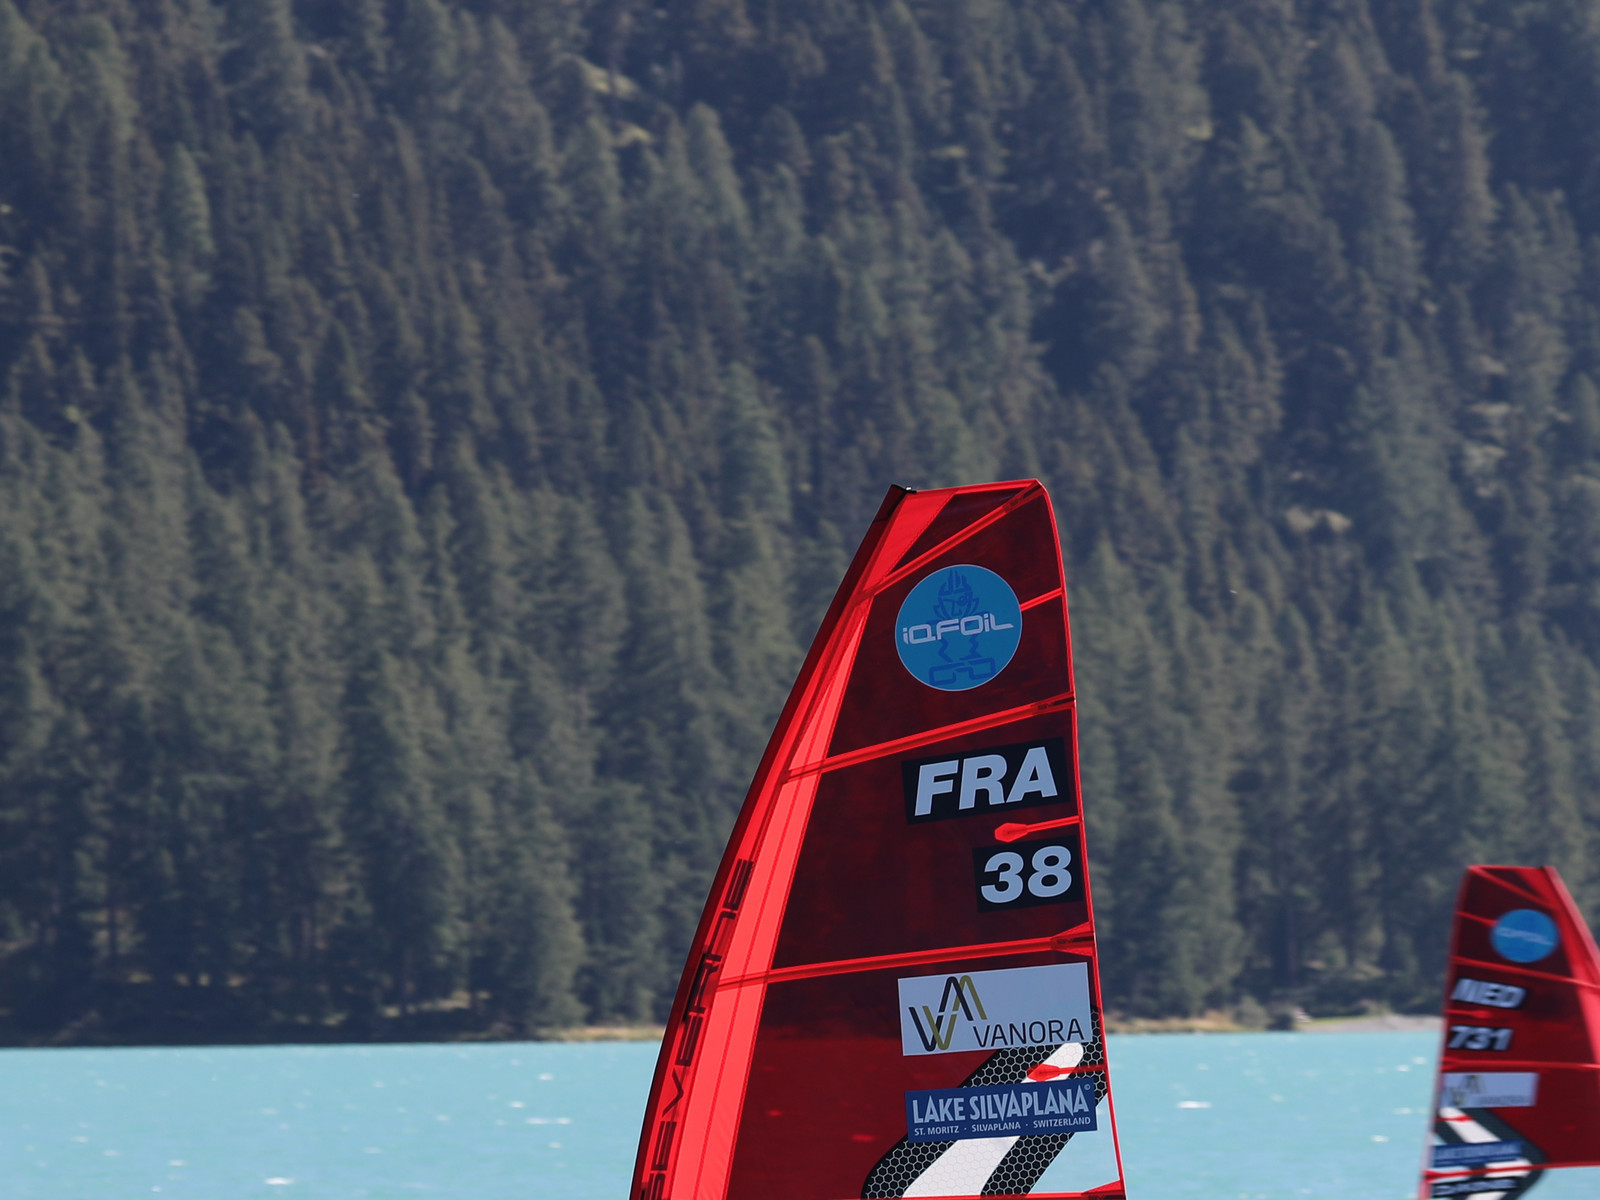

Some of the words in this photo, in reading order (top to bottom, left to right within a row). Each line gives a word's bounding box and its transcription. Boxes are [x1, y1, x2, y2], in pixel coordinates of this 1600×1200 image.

[914, 746, 1058, 817] FRA
[981, 845, 1072, 904] 38
[1450, 978, 1526, 1008] NED
[973, 1018, 1085, 1048] VANORA
[1448, 1025, 1514, 1050] 731
[912, 1095, 966, 1124] LAKE
[969, 1084, 1089, 1122] SILVAPLANA
[914, 1127, 926, 1136] ST.
[927, 1125, 960, 1136] MORITZ
[971, 1121, 1021, 1133] SILVAPLANA
[1033, 1116, 1091, 1129] SWITZERLAND
